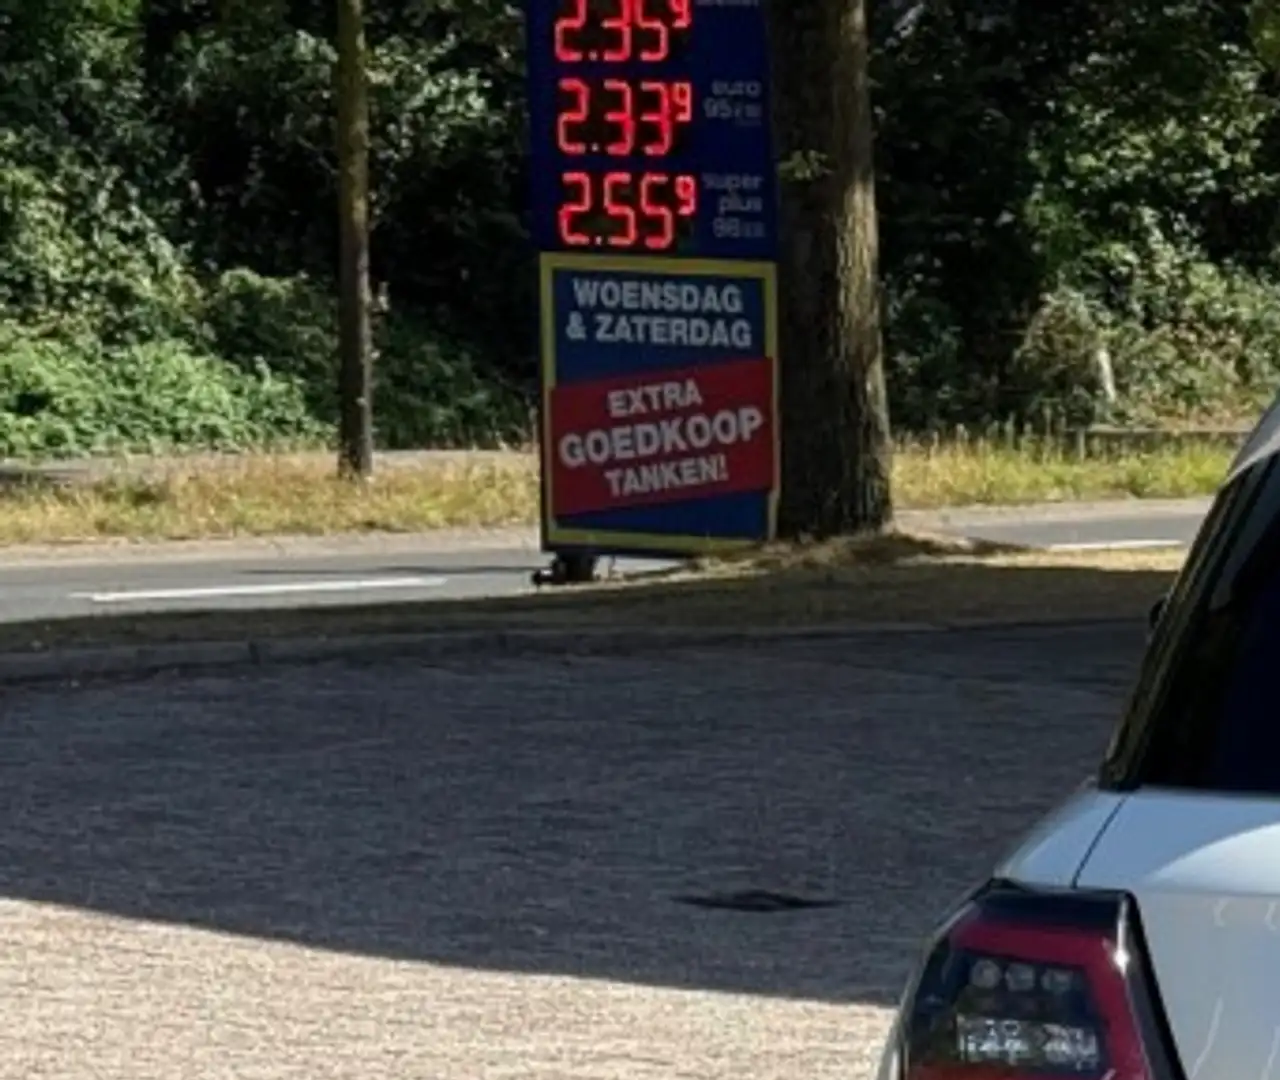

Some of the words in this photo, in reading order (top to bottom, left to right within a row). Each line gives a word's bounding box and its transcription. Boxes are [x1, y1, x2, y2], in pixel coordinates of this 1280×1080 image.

[557, 78, 692, 154] 2.339
[559, 172, 696, 248] 2.559
[572, 278, 743, 314] WOENSDAG
[566, 312, 586, 341] &
[595, 315, 752, 348] ZATERDAG
[607, 379, 703, 417] EXTRA
[559, 408, 763, 467] GOEDKOOP
[605, 454, 728, 497] TANKEN!
